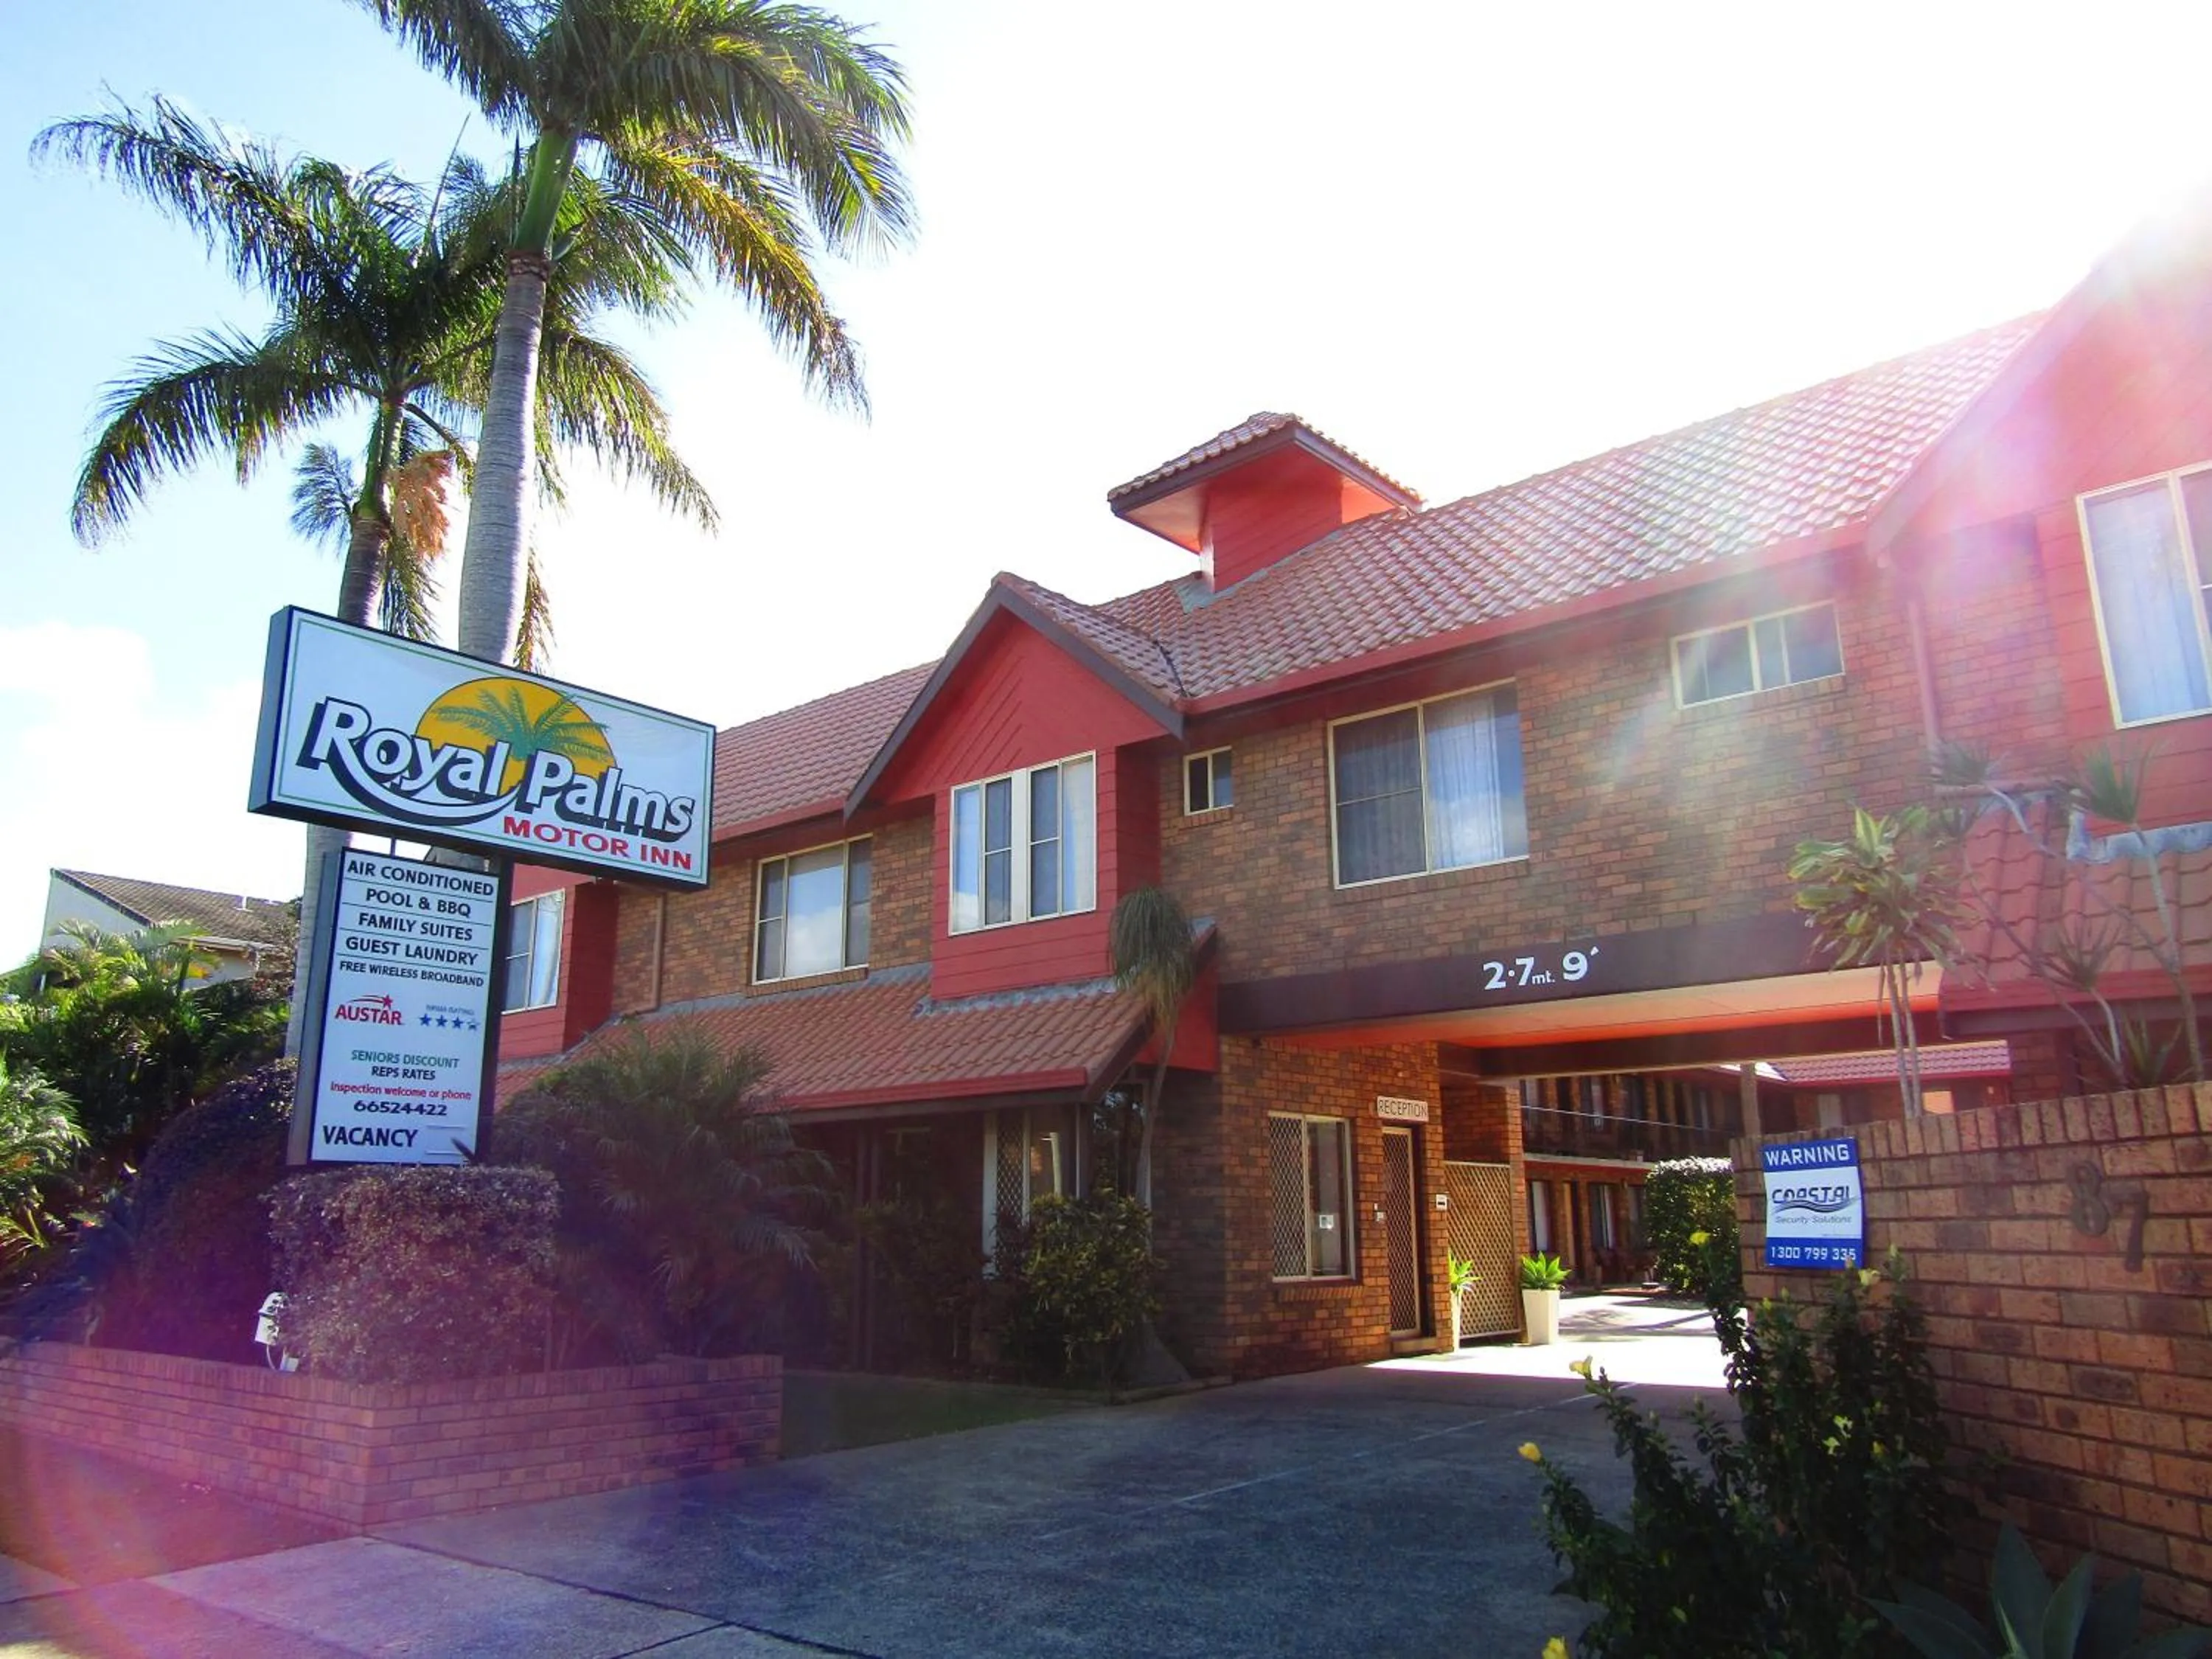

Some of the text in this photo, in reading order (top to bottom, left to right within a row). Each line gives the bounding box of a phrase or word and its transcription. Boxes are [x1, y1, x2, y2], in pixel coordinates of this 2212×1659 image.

[296, 696, 695, 843] Royal Palms
[503, 816, 692, 871] MOTOR INN
[347, 860, 494, 896] AIR CONDITIONED
[366, 888, 471, 918] POOL & BBQ
[358, 912, 473, 941] FAMILY SUITES
[346, 936, 479, 966] GUEST LAUNDRY
[339, 960, 484, 987] FREE WIRELESS BROADBAND
[335, 1004, 403, 1026] AUSTAR
[351, 1050, 460, 1068] SENIORS DISCOUNT
[372, 1065, 436, 1080] REPS RATES
[330, 1081, 381, 1094] Inspection
[384, 1087, 427, 1097] welcome
[442, 1088, 472, 1100] phone
[354, 1100, 448, 1116] 66524422
[1379, 1099, 1427, 1117] RECEPTION
[323, 1125, 418, 1147] VACANCY
[1765, 1144, 1850, 1166] WARNING
[2067, 1160, 2149, 1273] 87
[1772, 1246, 1801, 1259] 1300
[1804, 1247, 1828, 1261] 799
